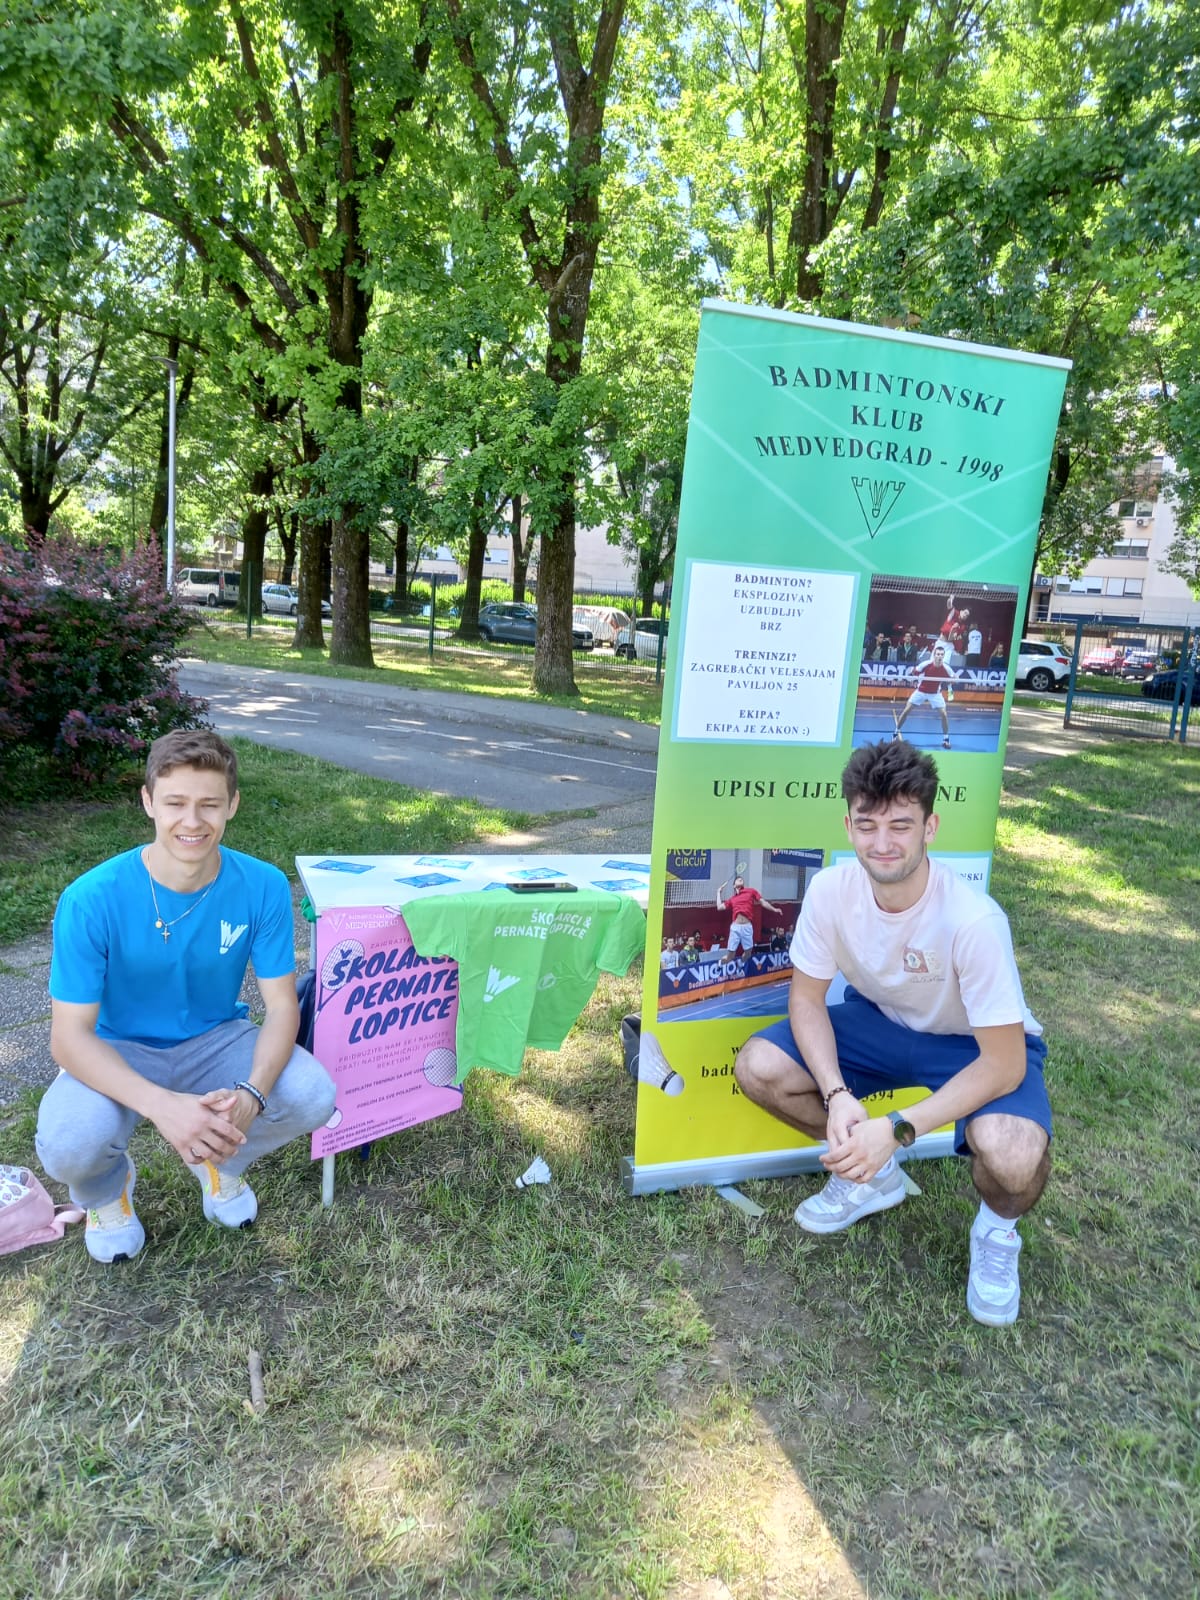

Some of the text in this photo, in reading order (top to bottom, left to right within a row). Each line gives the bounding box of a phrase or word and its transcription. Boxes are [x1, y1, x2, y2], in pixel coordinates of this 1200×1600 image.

[768, 365, 1006, 416] BADMINTONSKI
[851, 405, 924, 432] KLUB
[754, 435, 933, 467] MEDVEDGRAD
[956, 454, 1004, 482] 1998
[734, 573, 812, 588] BADMINTON?
[733, 589, 814, 603] EKSPLOZIVAN
[740, 605, 805, 617] UZBUDLJIV
[760, 621, 783, 632] BRZ
[734, 650, 797, 662] TRENINZI?
[690, 662, 836, 679] ZAGREBAČKI VELESAJAM
[727, 680, 798, 692] PAVILJON 25
[739, 709, 780, 719] EKIPA?
[706, 723, 740, 733] EKIPA
[743, 725, 756, 733] JE
[760, 725, 799, 735] ZAKON
[712, 780, 967, 802] UPISI CIJE NE
[675, 856, 707, 867] CIRCUIT
[530, 908, 592, 929] ŠKOARCI &
[494, 922, 586, 940] PERNATE OPTICE
[344, 968, 459, 1015] PERNATE
[348, 995, 456, 1044] LOPTICE
[384, 1042, 401, 1051] NAM
